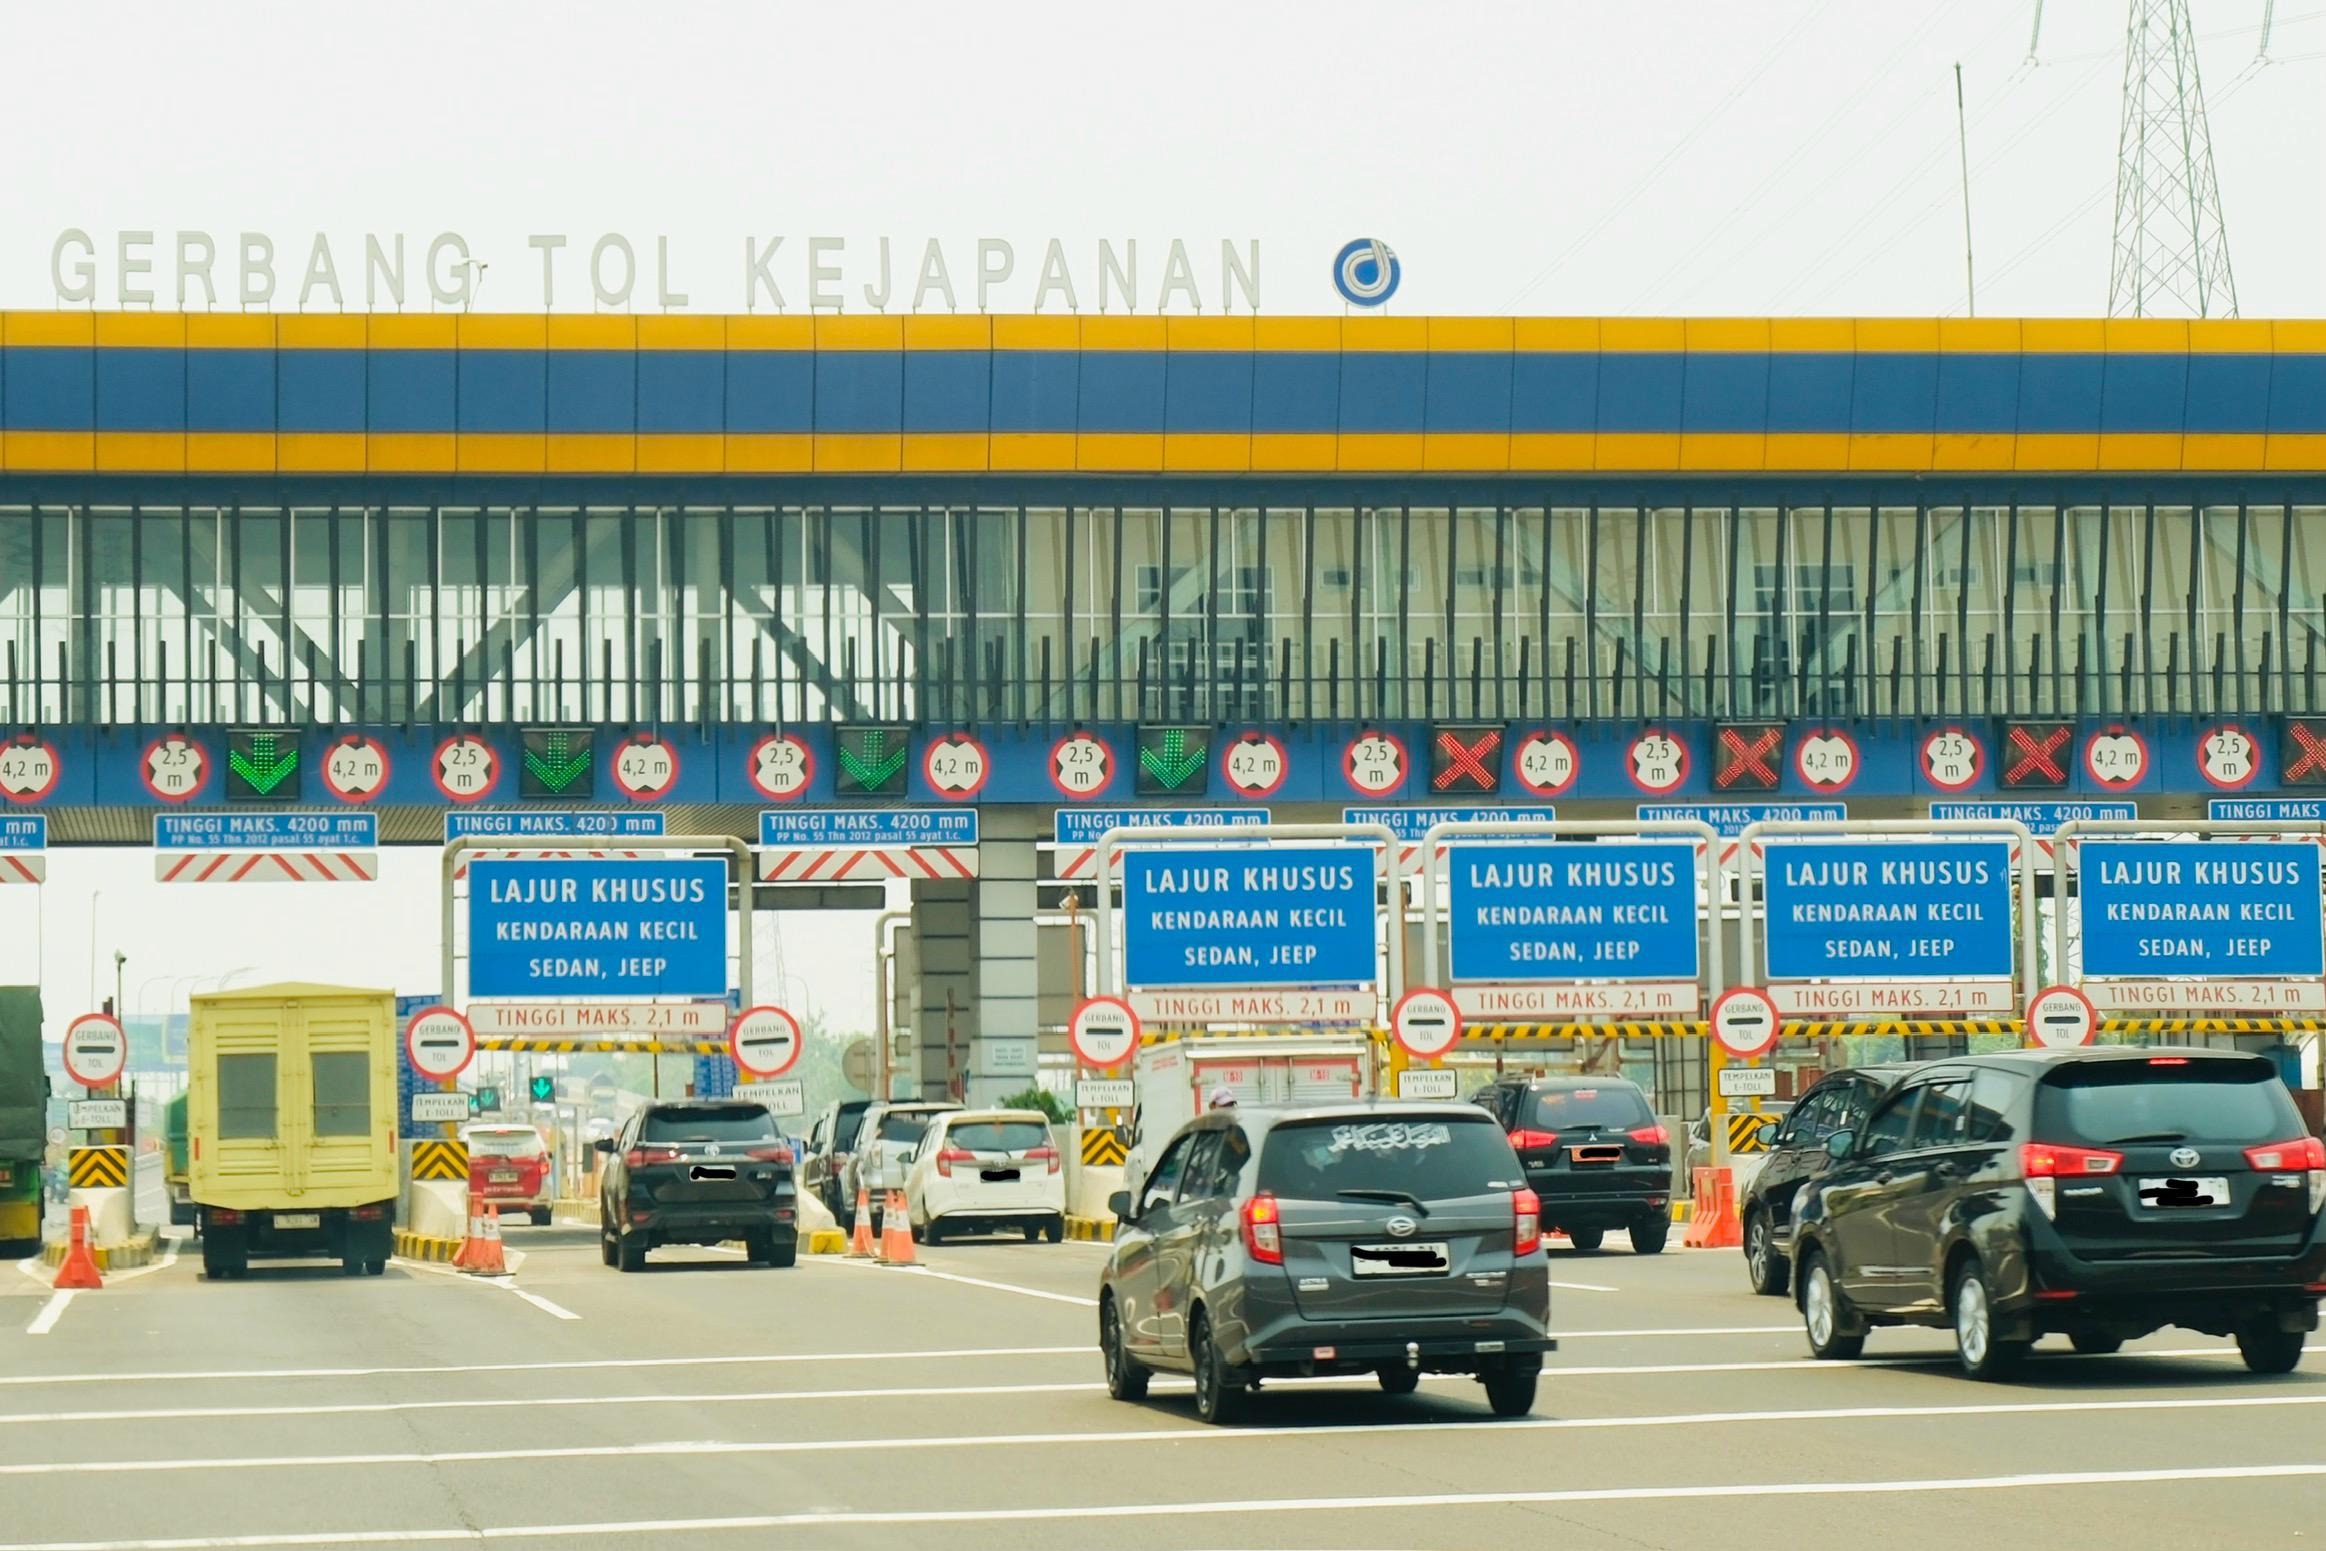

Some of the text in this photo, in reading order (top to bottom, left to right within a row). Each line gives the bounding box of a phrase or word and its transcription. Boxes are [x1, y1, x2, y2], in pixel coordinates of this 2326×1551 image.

[52, 229, 1260, 308] GERBANG TOL KEJAPANAN
[1364, 746, 1387, 763] 2,5
[1646, 743, 1669, 760] 2,5
[1939, 740, 1962, 757] 2,5
[2217, 739, 2239, 754] 2,5
[162, 749, 187, 767] 2,5
[452, 749, 476, 766] 2,5
[770, 748, 793, 766] 2,5
[1069, 747, 1093, 765] 2,5
[1525, 756, 1568, 771] 4,2 m
[1806, 753, 1848, 769] 4,2 m
[2095, 750, 2137, 766] 4,2 m
[2, 762, 48, 779] 4,2 m
[333, 763, 378, 779] 4,2 m
[623, 759, 667, 776] 4,2 m
[934, 759, 978, 776] 4,2 m
[1233, 758, 1275, 774] 4,2 m
[1651, 767, 1665, 779] m
[1945, 763, 1959, 776] m
[2223, 762, 2237, 775] m
[168, 773, 181, 787] m
[458, 774, 471, 786] m
[775, 771, 789, 785] m
[1075, 771, 1088, 784] m
[1370, 770, 1383, 782] m
[1353, 813, 1407, 827] TINGGI
[1710, 810, 1755, 823] MAKS.
[1939, 807, 2128, 820] TINGGI MAKS. 4200 mm
[2219, 805, 2271, 818] TINGGI
[7, 821, 36, 832] mm
[165, 818, 367, 833] TINGGI MAKS. 4200 mm
[455, 817, 511, 831] TINGGI
[521, 817, 569, 831] MAKS.
[626, 818, 655, 831] mm
[770, 815, 968, 830] TINGGI MAKS. 4200 mm
[1066, 815, 1120, 829] TINGGI
[1184, 814, 1223, 826] 4200
[1232, 816, 1261, 825] mm
[777, 831, 960, 842] PP No. 55 Thn 2012 pasal 55 ayat 1.c.
[1146, 867, 1353, 893] LAJUR KHUSUS
[1471, 863, 1674, 888] LAJUR KHUSUS
[1786, 861, 1989, 886] LAJUR KHUSUS
[2101, 862, 2300, 884] LAJUR KHUSUS
[491, 878, 704, 903] LAJUR KHUSUS
[1152, 909, 1346, 929] KENDARAAN KECIL
[1478, 906, 1668, 925] KENDARAAN KECIL
[1793, 904, 1983, 922] KENDARAAN KECIL
[2108, 904, 2295, 920] KENDARAAN KECIL
[497, 921, 697, 940] KENDARAAN KECIL
[1185, 946, 1316, 967] SEDAN, JEEP
[1510, 942, 1639, 962] SEDAN, JEEP
[1826, 940, 1954, 960] SEDAN, JEEP
[2140, 939, 2271, 958] SEDAN, JEEP
[530, 959, 666, 979] SEDAN, JEEP
[1478, 991, 1672, 1010] TINGGI MAKS. 2,1 m
[1794, 989, 1987, 1008] TINGGI MAKS. 2,1 m
[2109, 986, 2300, 1004] TINGGI MAKS. 2,1 m
[1155, 997, 1350, 1017] TINGGI MAKS. 2,1 m
[2043, 1002, 2080, 1013] GERBANG
[496, 1009, 699, 1028] TINGGI MAKS. 2,1 m
[2056, 1028, 2069, 1039] TOL
